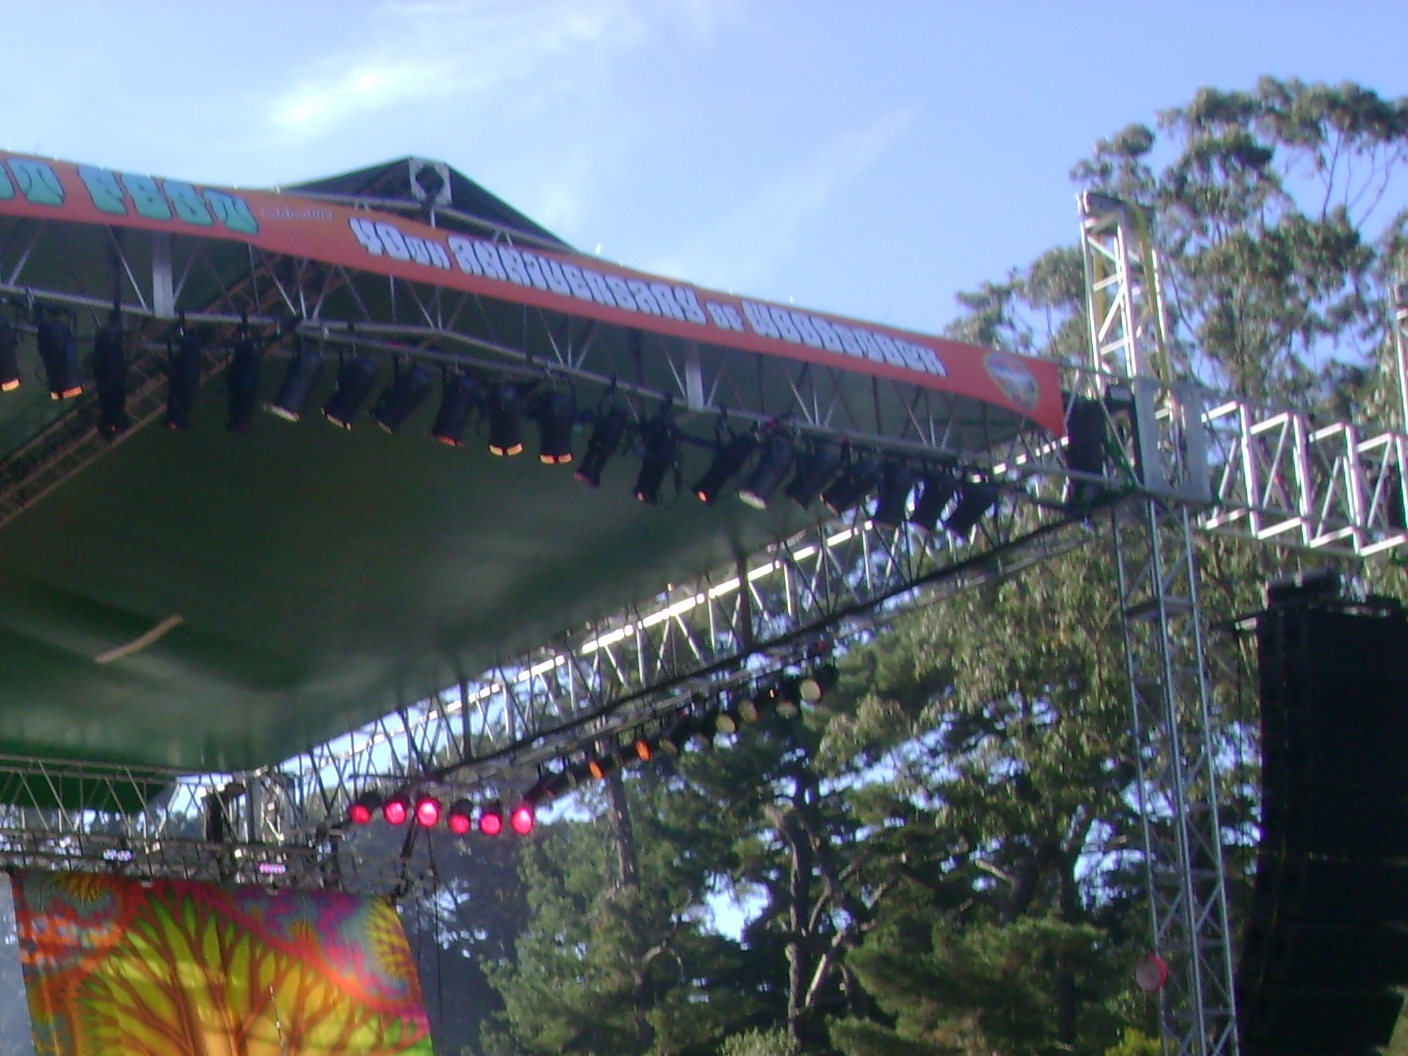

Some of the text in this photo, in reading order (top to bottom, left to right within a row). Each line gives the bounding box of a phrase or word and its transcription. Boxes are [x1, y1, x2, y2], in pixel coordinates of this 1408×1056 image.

[77, 166, 259, 235] FEST
[447, 235, 708, 325] ANNIVERSARY
[742, 300, 947, 377] WOODSTOCK
